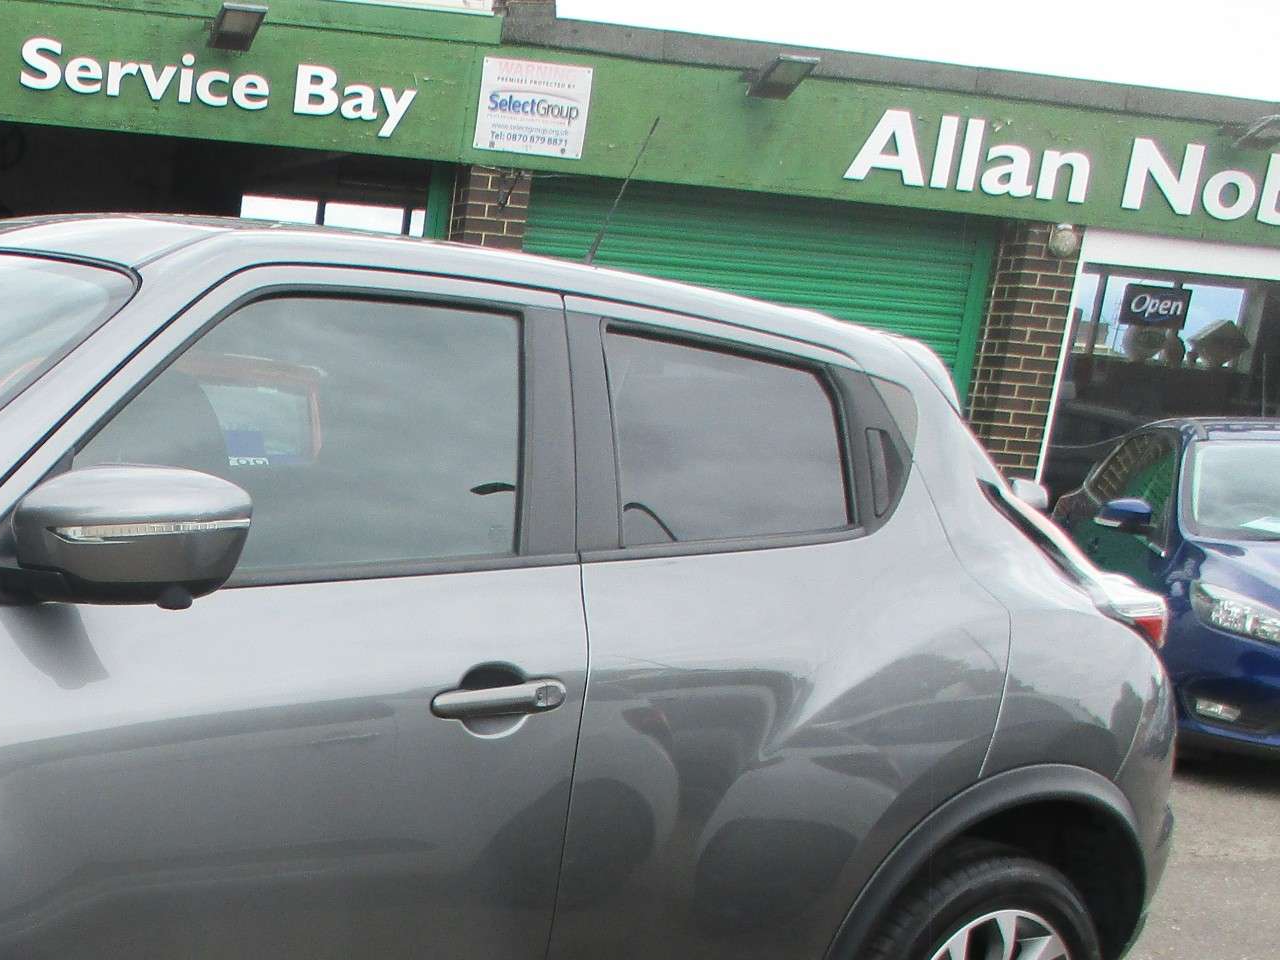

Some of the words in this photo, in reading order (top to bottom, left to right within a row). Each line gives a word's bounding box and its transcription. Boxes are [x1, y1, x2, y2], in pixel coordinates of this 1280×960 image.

[20, 36, 270, 111] Service
[293, 63, 418, 138] Bay
[497, 76, 528, 85] PREMISES
[529, 79, 566, 89] PROTECTED
[488, 91, 579, 127] SelectGroup
[490, 131, 505, 140] Tel:
[506, 133, 528, 142] 0870
[529, 135, 546, 144] 879
[843, 108, 1091, 204] Allan
[1130, 293, 1183, 318] Open
